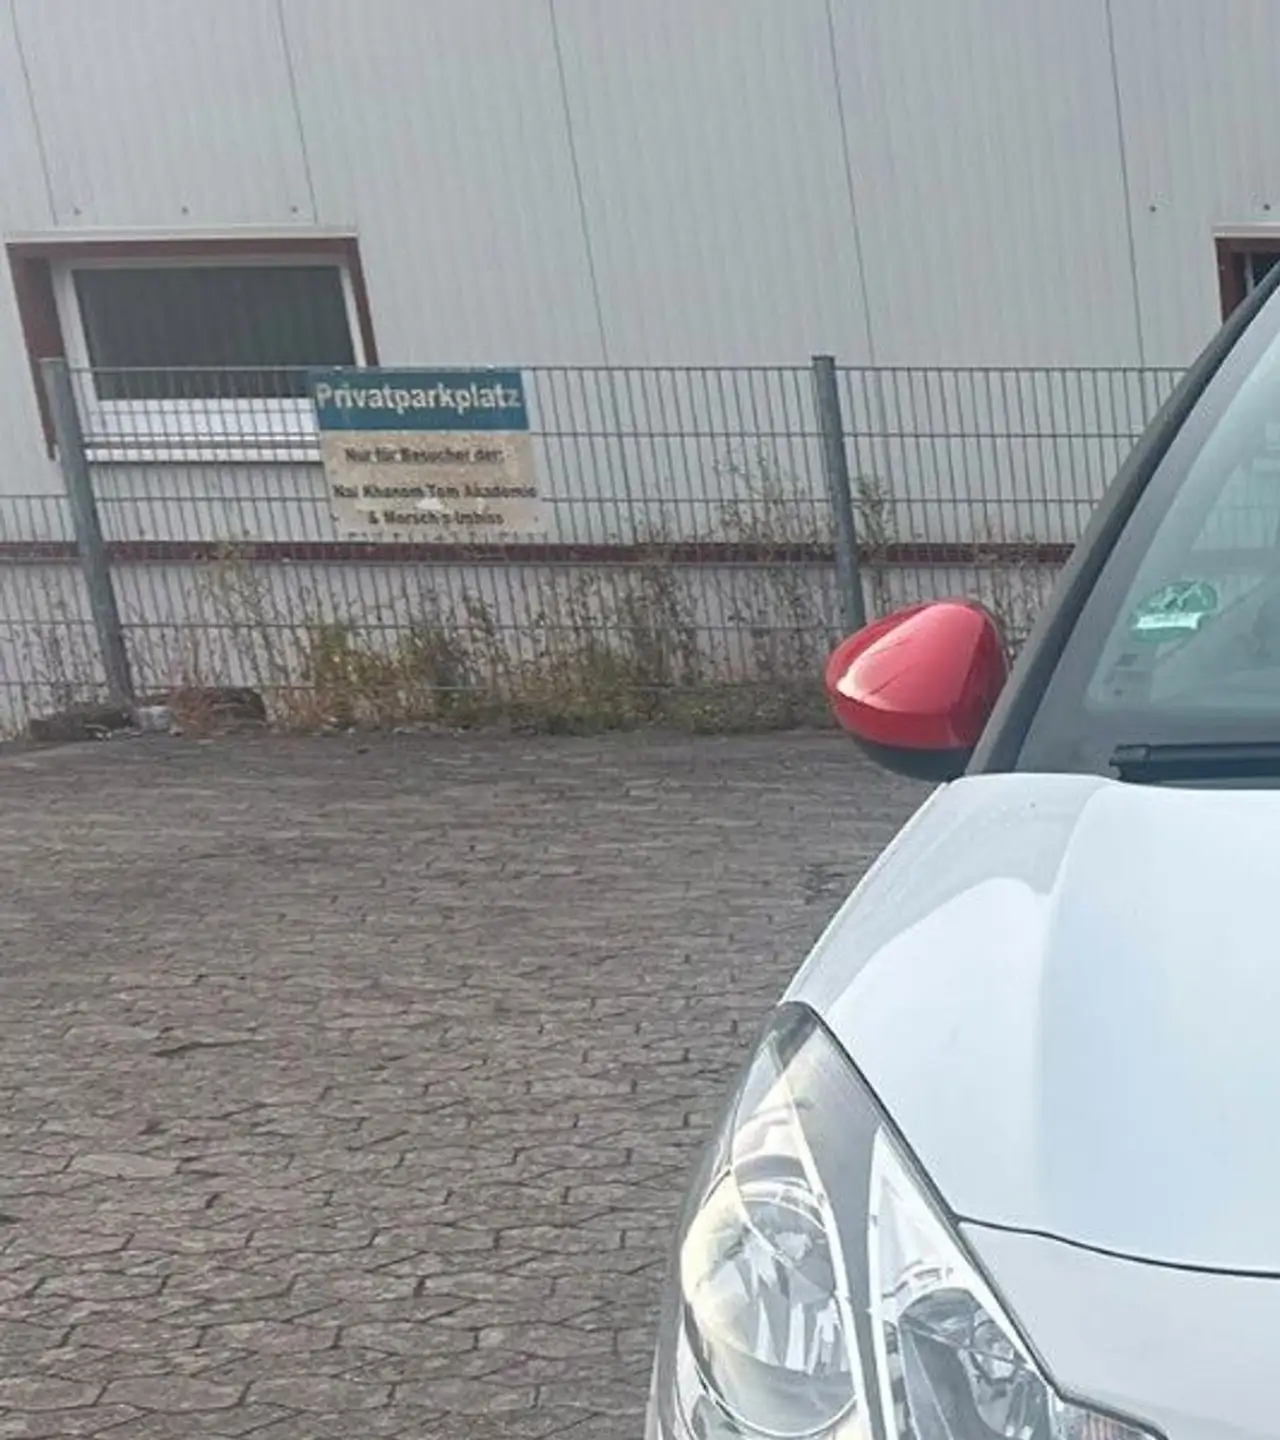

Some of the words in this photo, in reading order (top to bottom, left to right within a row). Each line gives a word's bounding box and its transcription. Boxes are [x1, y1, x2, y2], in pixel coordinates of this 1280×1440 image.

[315, 381, 522, 415] Privatparkplatz
[345, 448, 371, 464] Nur
[400, 447, 470, 464] Besucher
[464, 484, 538, 498] Akademie
